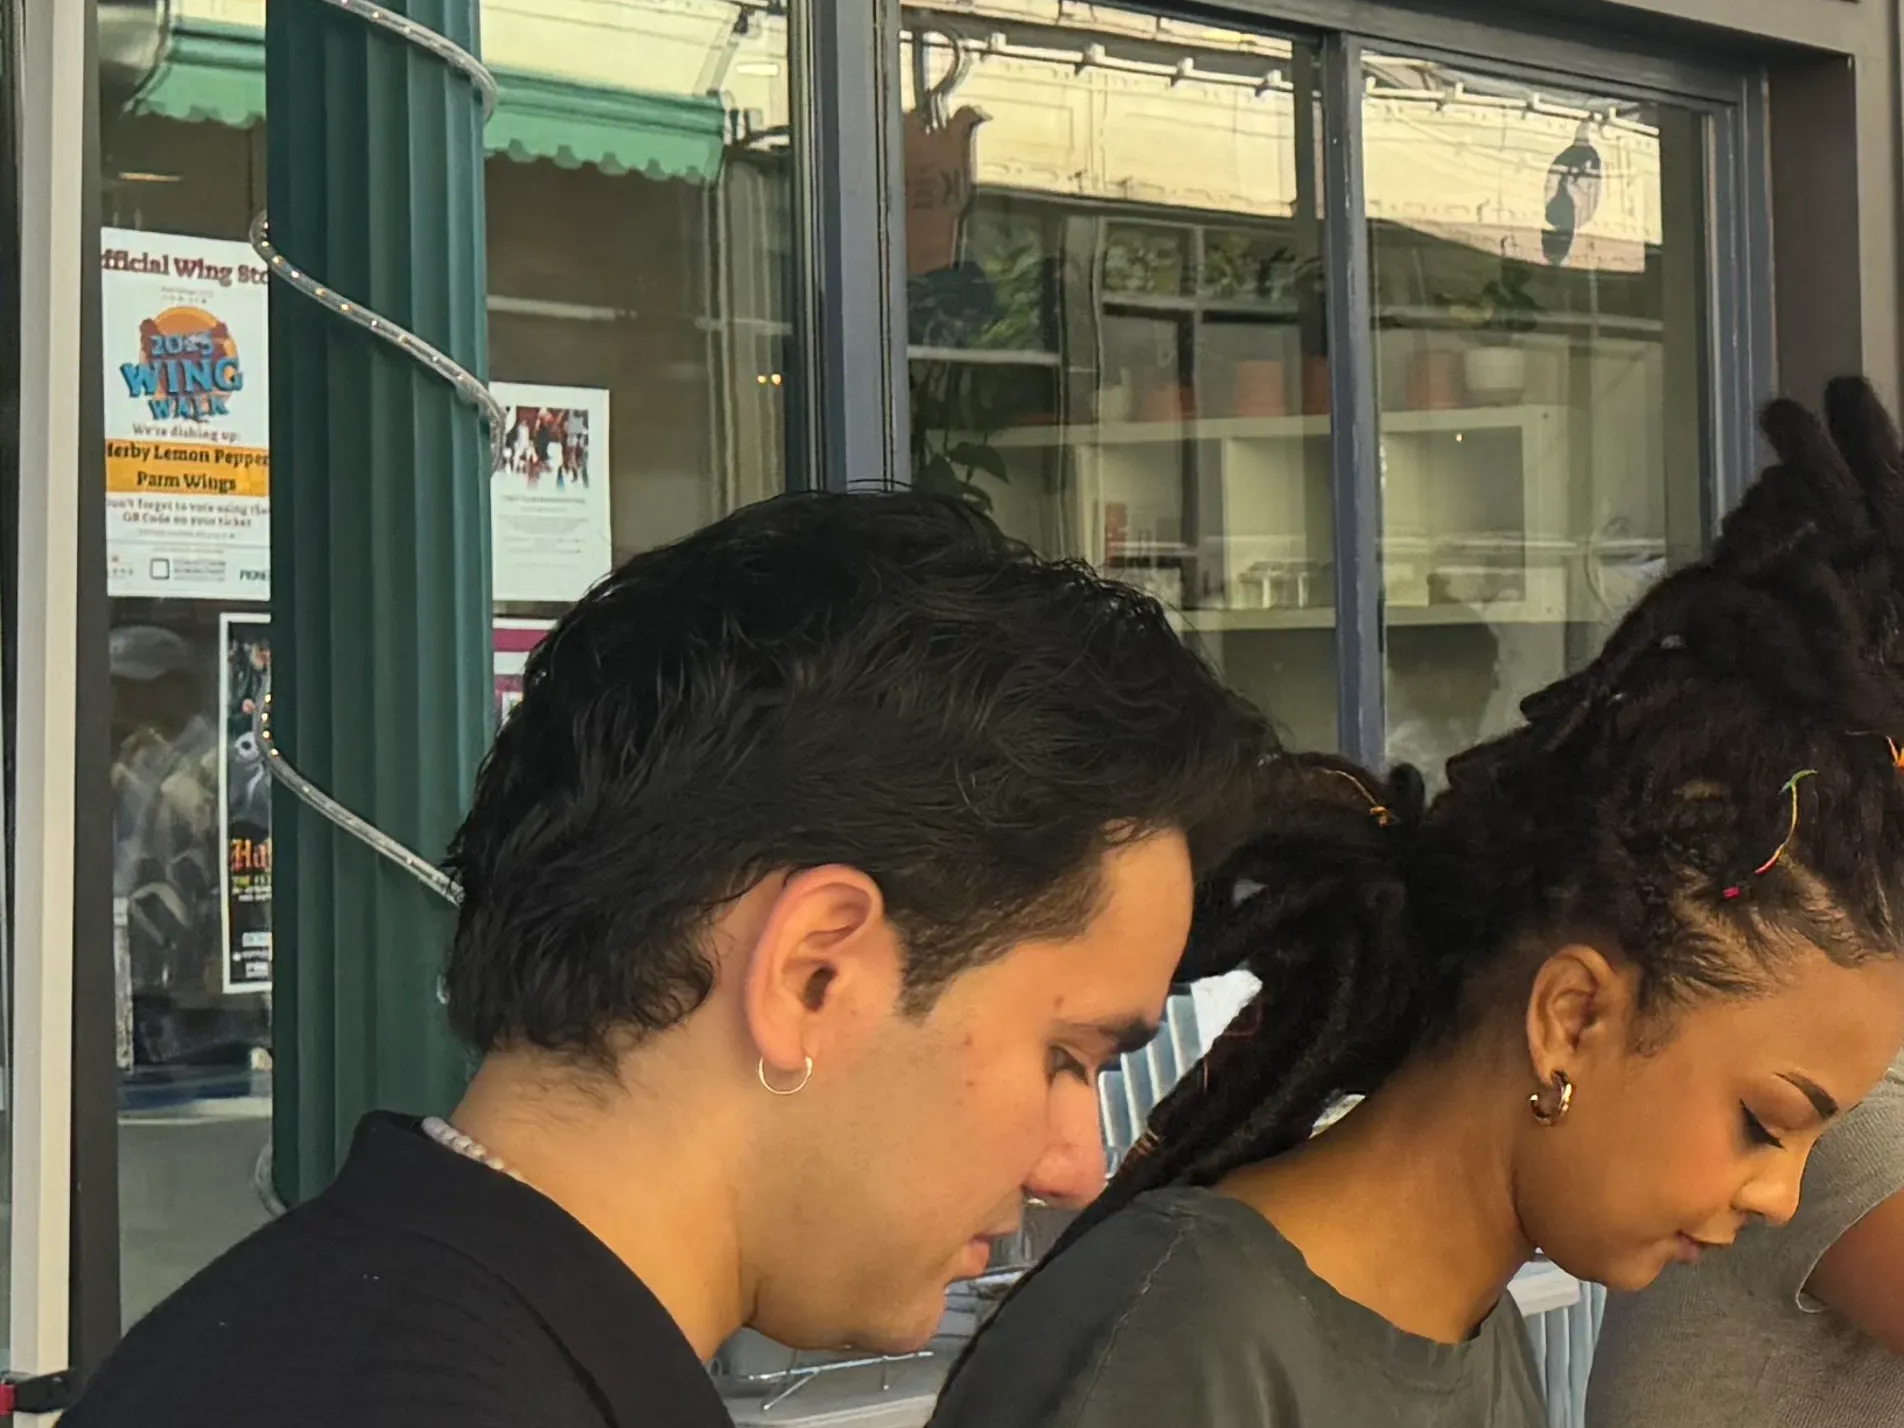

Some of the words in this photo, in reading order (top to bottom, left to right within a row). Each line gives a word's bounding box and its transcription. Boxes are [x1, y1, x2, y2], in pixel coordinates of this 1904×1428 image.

[101, 248, 169, 276] fficial
[173, 257, 233, 287] Wing
[150, 332, 214, 357] 2025
[120, 357, 243, 399] WING
[147, 395, 230, 423] WALK
[132, 422, 168, 437] We're
[170, 425, 218, 443] dishing
[154, 444, 210, 462] Lemon
[214, 448, 269, 468] Pepper
[137, 470, 180, 488] Parm
[183, 473, 236, 494] Wings
[137, 498, 173, 513] forget
[175, 501, 188, 512] to
[190, 501, 214, 513] vote
